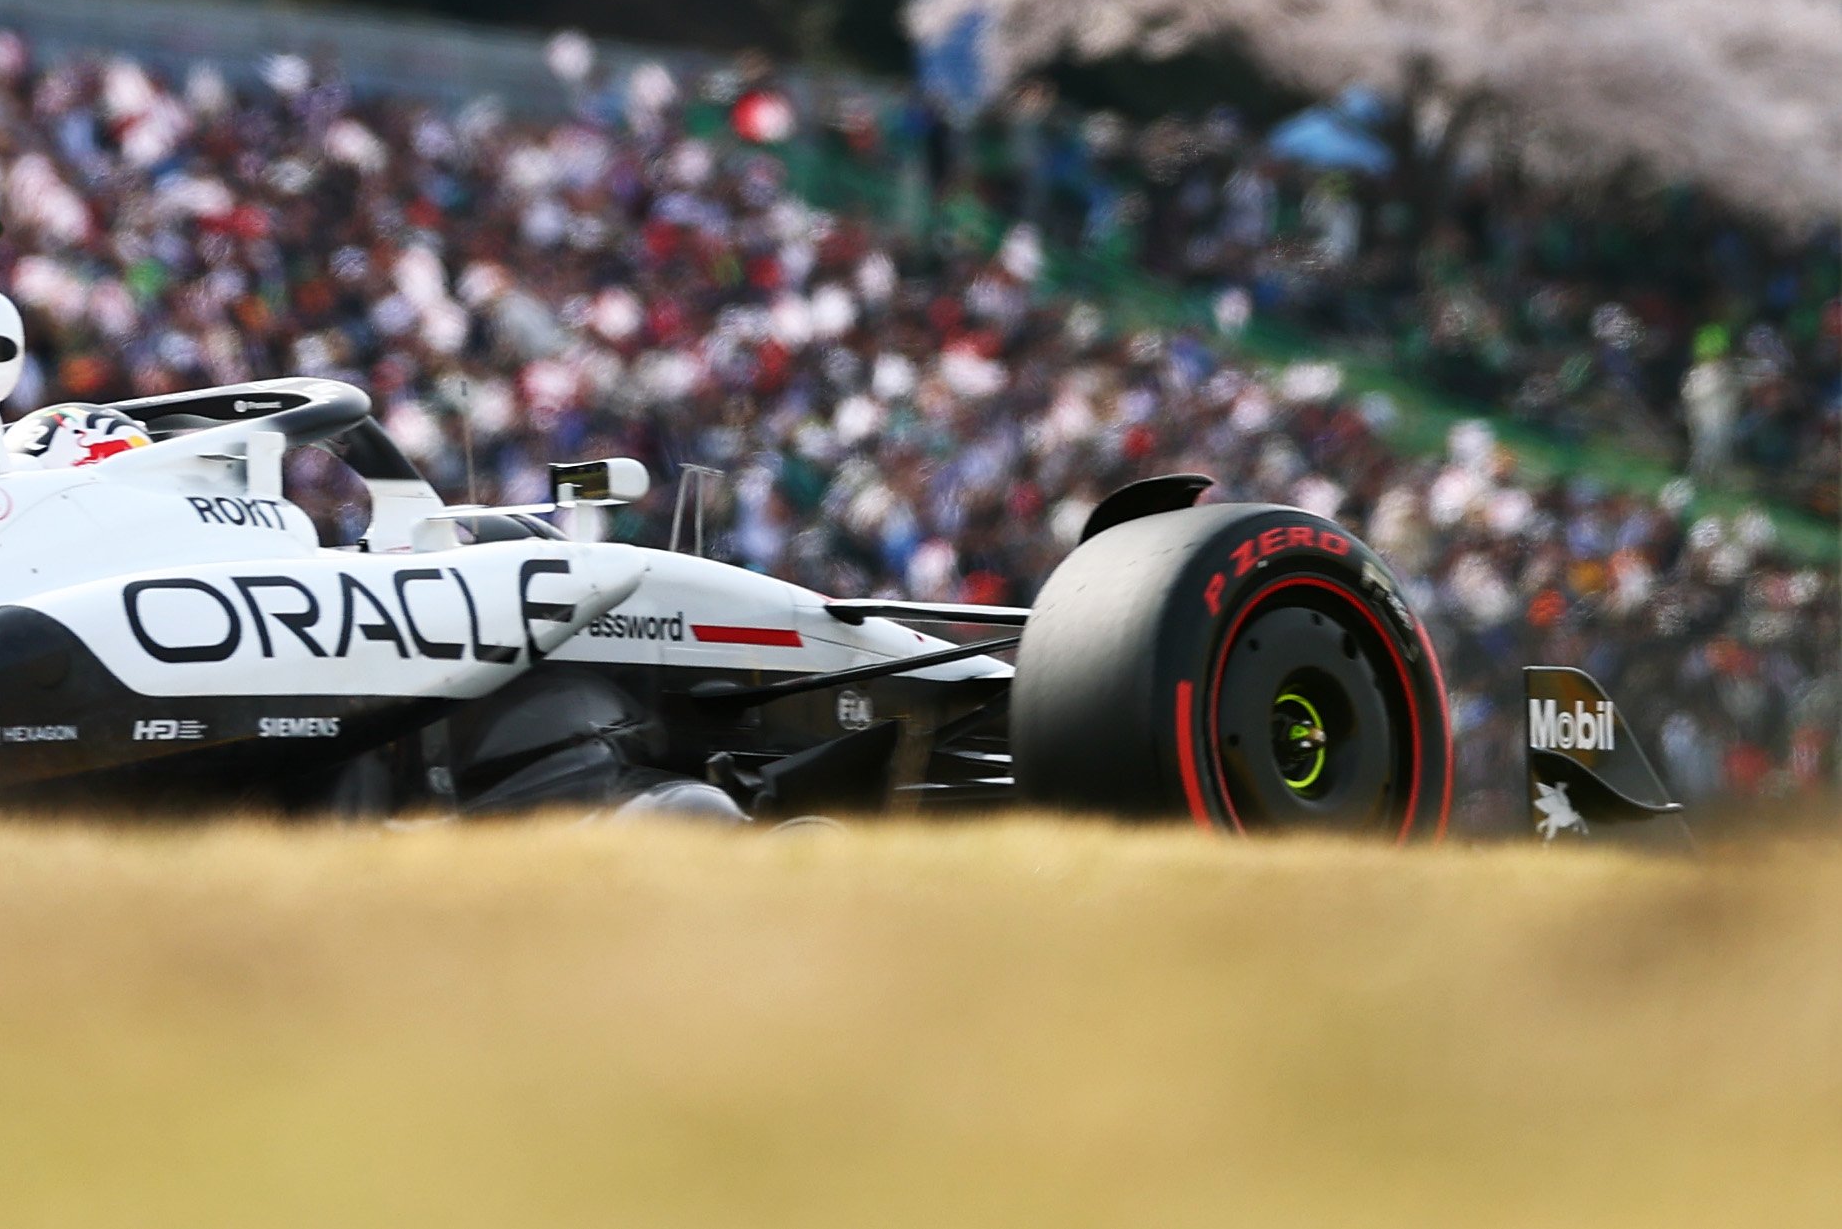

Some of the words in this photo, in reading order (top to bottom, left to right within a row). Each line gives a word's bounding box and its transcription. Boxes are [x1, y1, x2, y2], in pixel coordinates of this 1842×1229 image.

[185, 497, 285, 530] ROKT
[1204, 571, 1226, 617] P
[1229, 526, 1351, 577] ZERO
[123, 559, 577, 664] ORACLE
[574, 611, 684, 641] assword
[3, 724, 78, 742] HEXAGON
[257, 717, 341, 738] SIEMENS
[1529, 699, 1615, 750] Mobil
